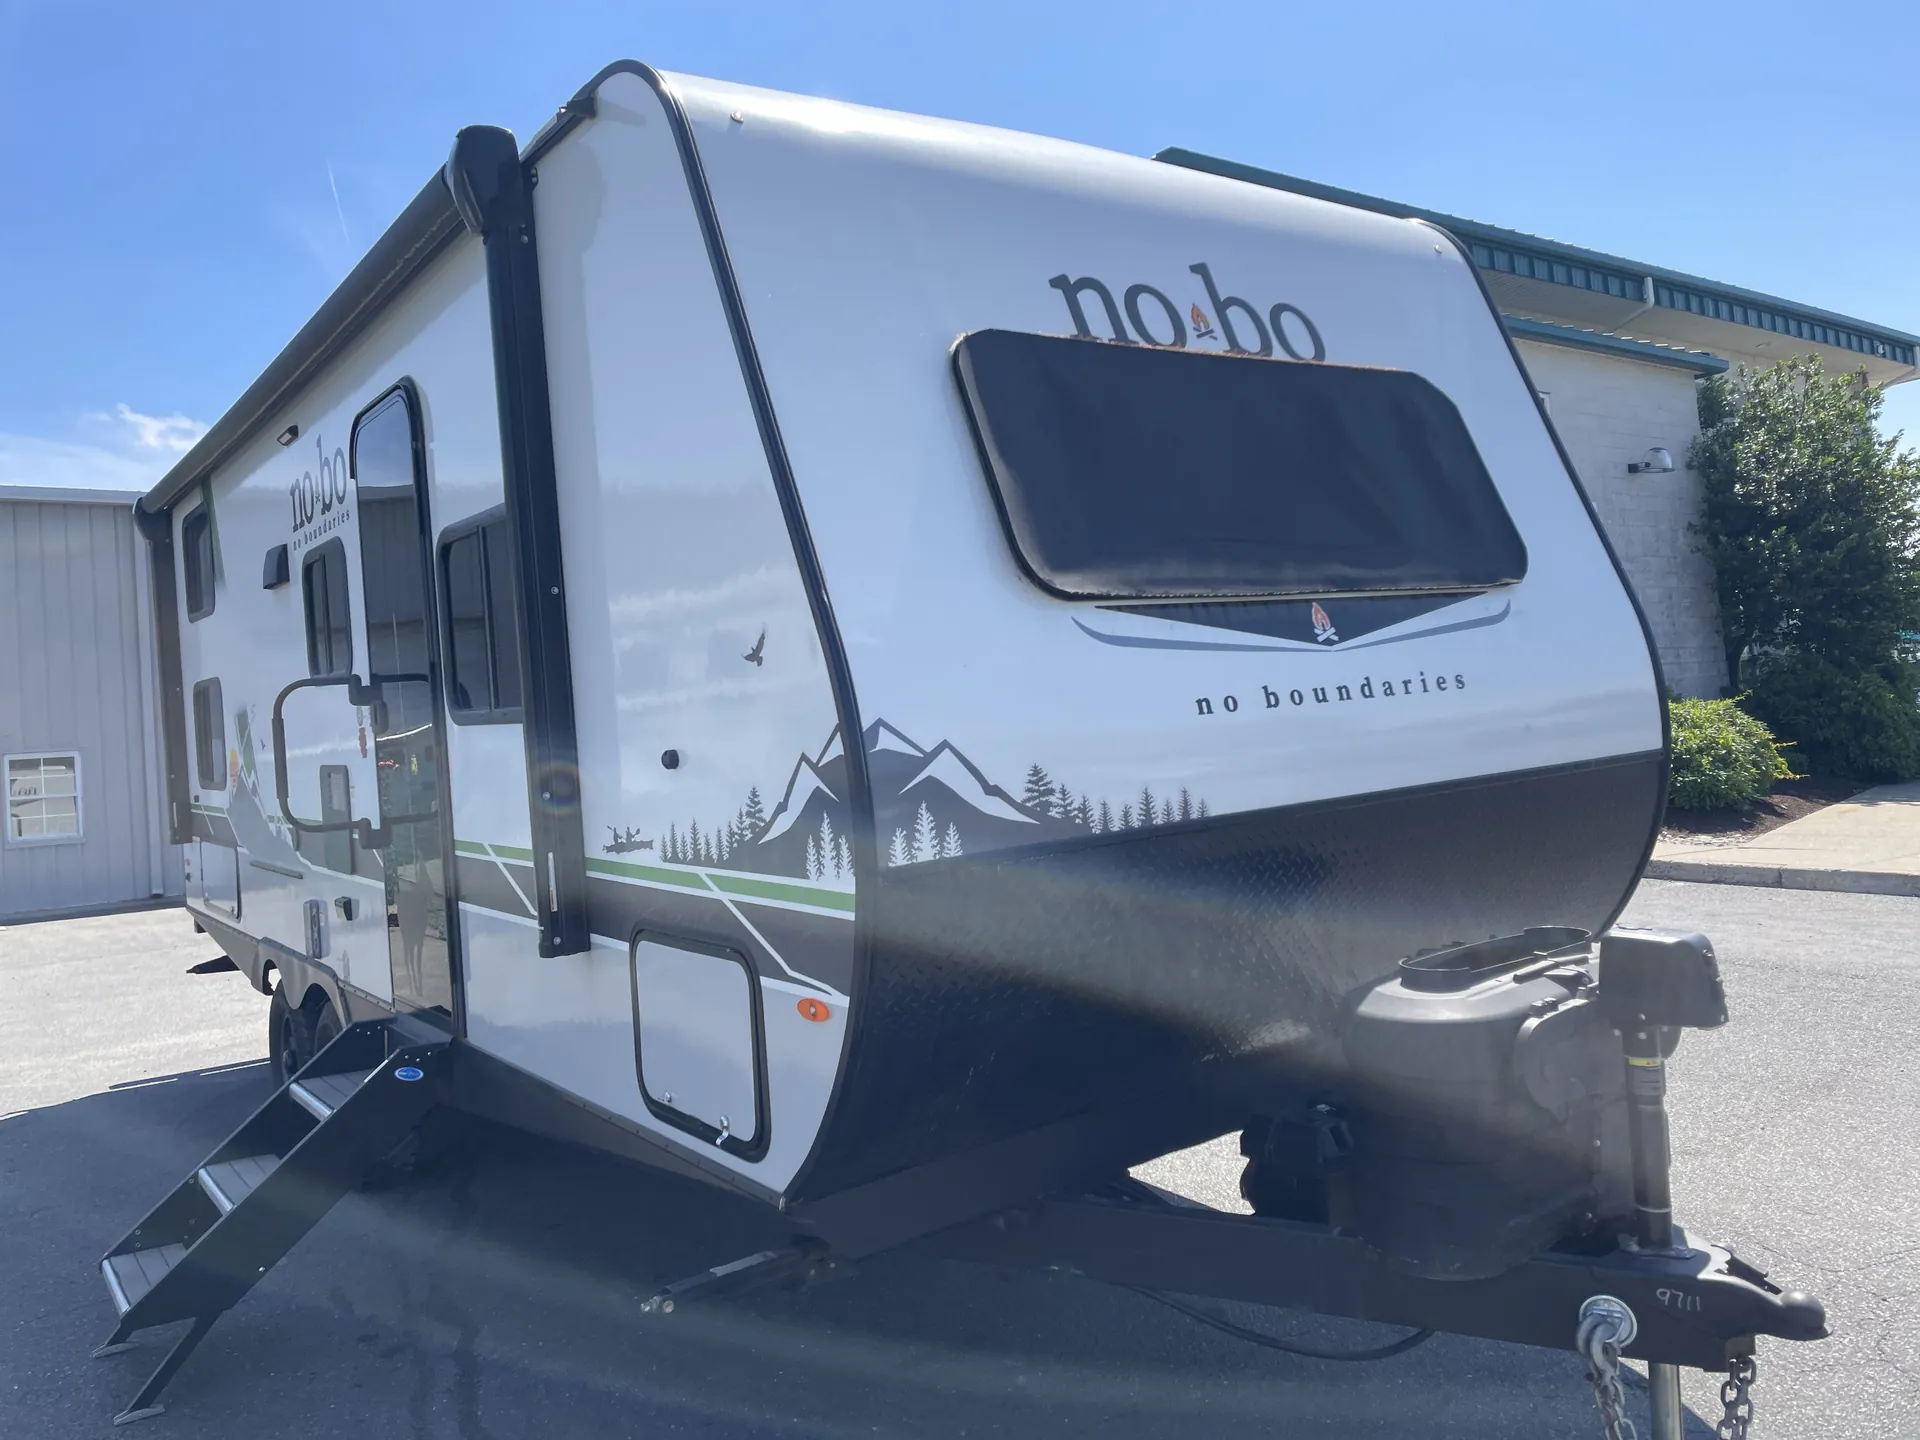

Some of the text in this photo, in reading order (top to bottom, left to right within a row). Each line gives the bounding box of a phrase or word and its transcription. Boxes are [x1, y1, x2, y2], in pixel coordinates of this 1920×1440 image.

[304, 510, 350, 544] boundaries
[1195, 671, 1466, 715] no boundaries
[1656, 1288, 1700, 1312] 9711
